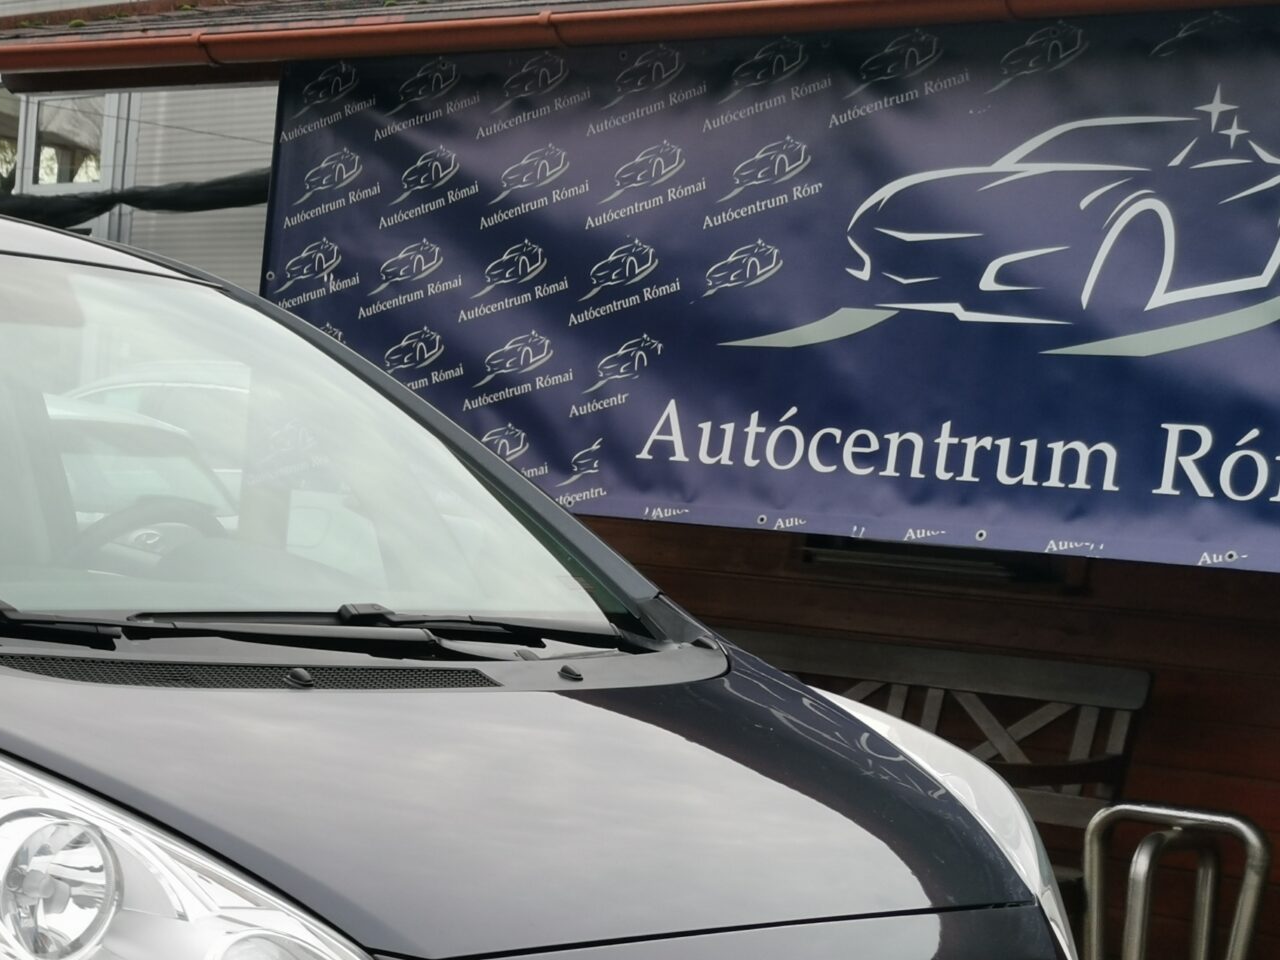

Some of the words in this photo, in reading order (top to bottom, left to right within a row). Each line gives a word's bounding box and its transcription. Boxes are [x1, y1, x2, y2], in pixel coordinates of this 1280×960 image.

[279, 111, 342, 143] Autócentrum
[344, 97, 376, 116] Római
[374, 108, 442, 141] Autócentrum
[446, 92, 480, 115] Római
[475, 104, 550, 140] Autócentrum
[554, 87, 591, 111] Római
[586, 101, 664, 136] Autócentrum
[668, 81, 707, 106] Római
[702, 95, 787, 132] Autócentrum
[790, 75, 832, 101] Római
[828, 88, 919, 128] Autócentrum
[924, 69, 970, 95] Római
[283, 196, 346, 229] Autócentrum
[349, 182, 381, 204] Római
[379, 195, 446, 229] Autócentrum
[448, 181, 479, 205] Római
[479, 194, 549, 230] Autócentrum
[552, 180, 589, 202] Római
[585, 194, 663, 230] Autócentrum
[667, 178, 706, 203] Római
[702, 191, 789, 230] Autócentrum
[358, 289, 424, 319] Autócentrum
[427, 275, 462, 297] Római
[458, 291, 532, 323] Autócentrum
[534, 277, 568, 299] Római
[568, 294, 640, 326] Autócentrum
[644, 278, 680, 303] Római
[431, 362, 464, 385] Római
[463, 382, 532, 411] Autócentrum
[536, 369, 573, 393] Római
[637, 399, 1120, 492] Autócentrum
[1152, 423, 1280, 502] Ró
